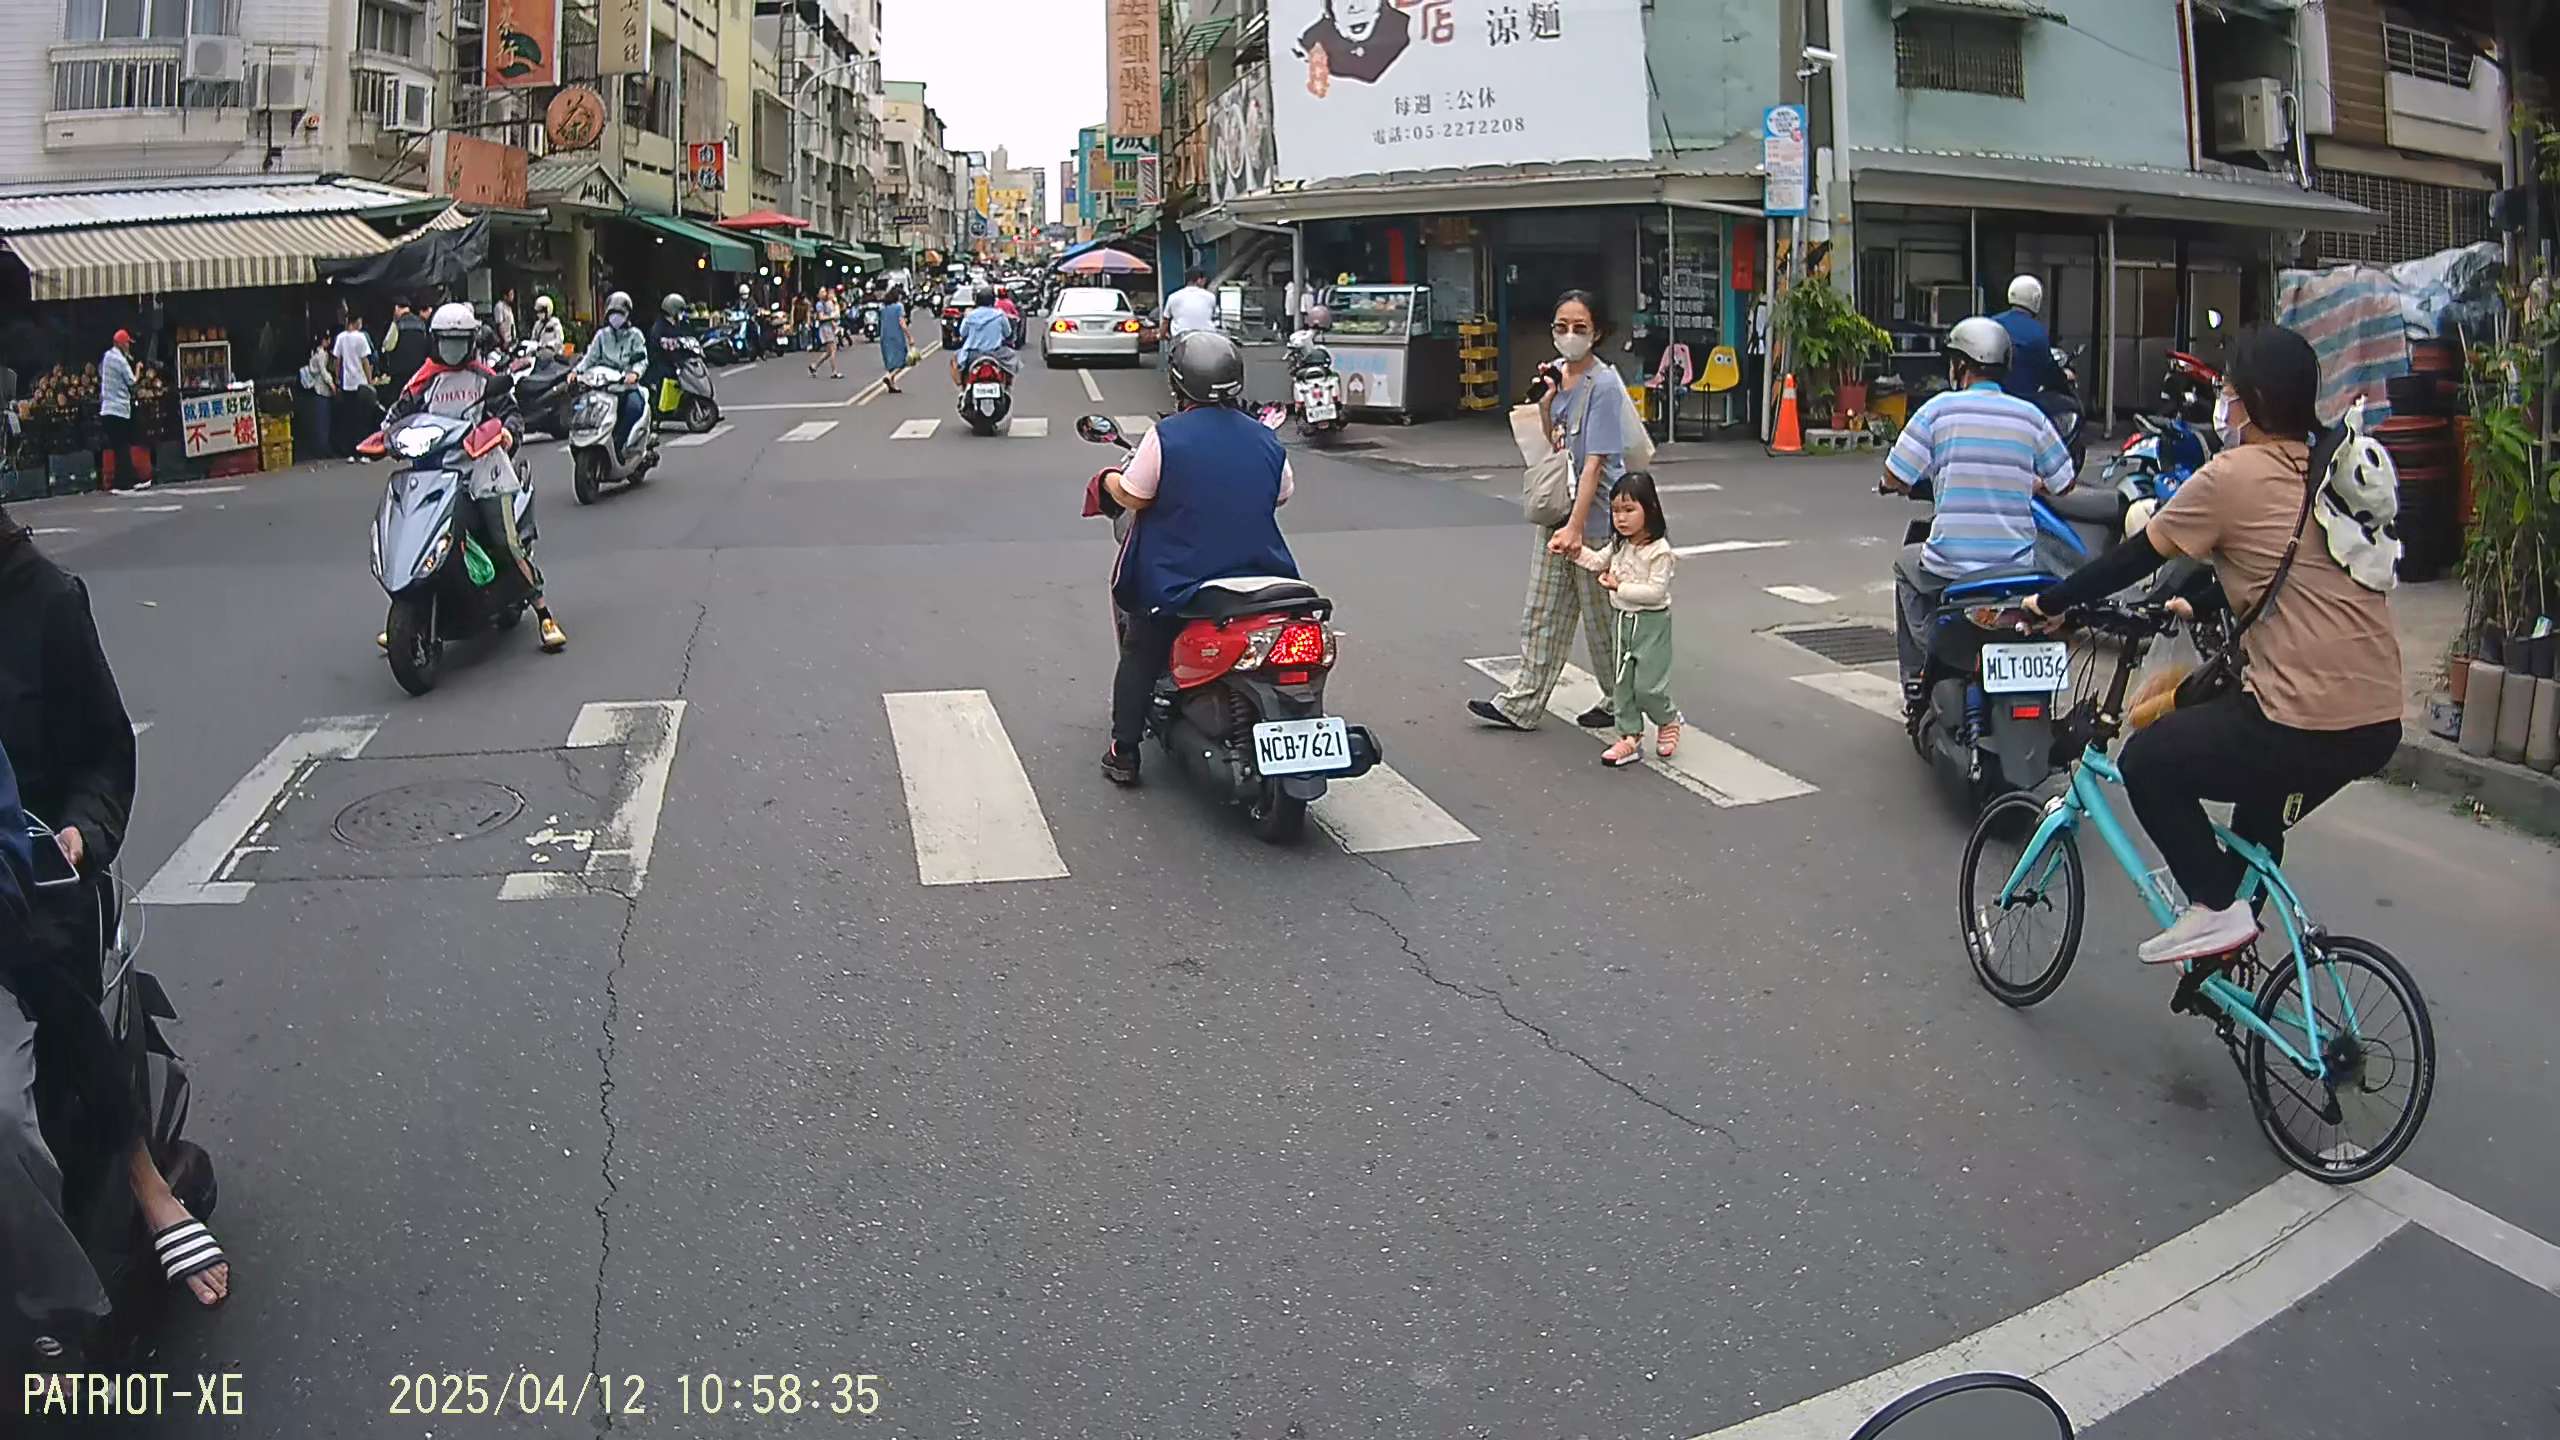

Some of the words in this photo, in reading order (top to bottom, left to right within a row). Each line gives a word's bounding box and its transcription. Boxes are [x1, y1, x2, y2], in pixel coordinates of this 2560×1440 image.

[1487, 1, 1562, 46] 涼麵
[186, 415, 256, 453] 不一樣
